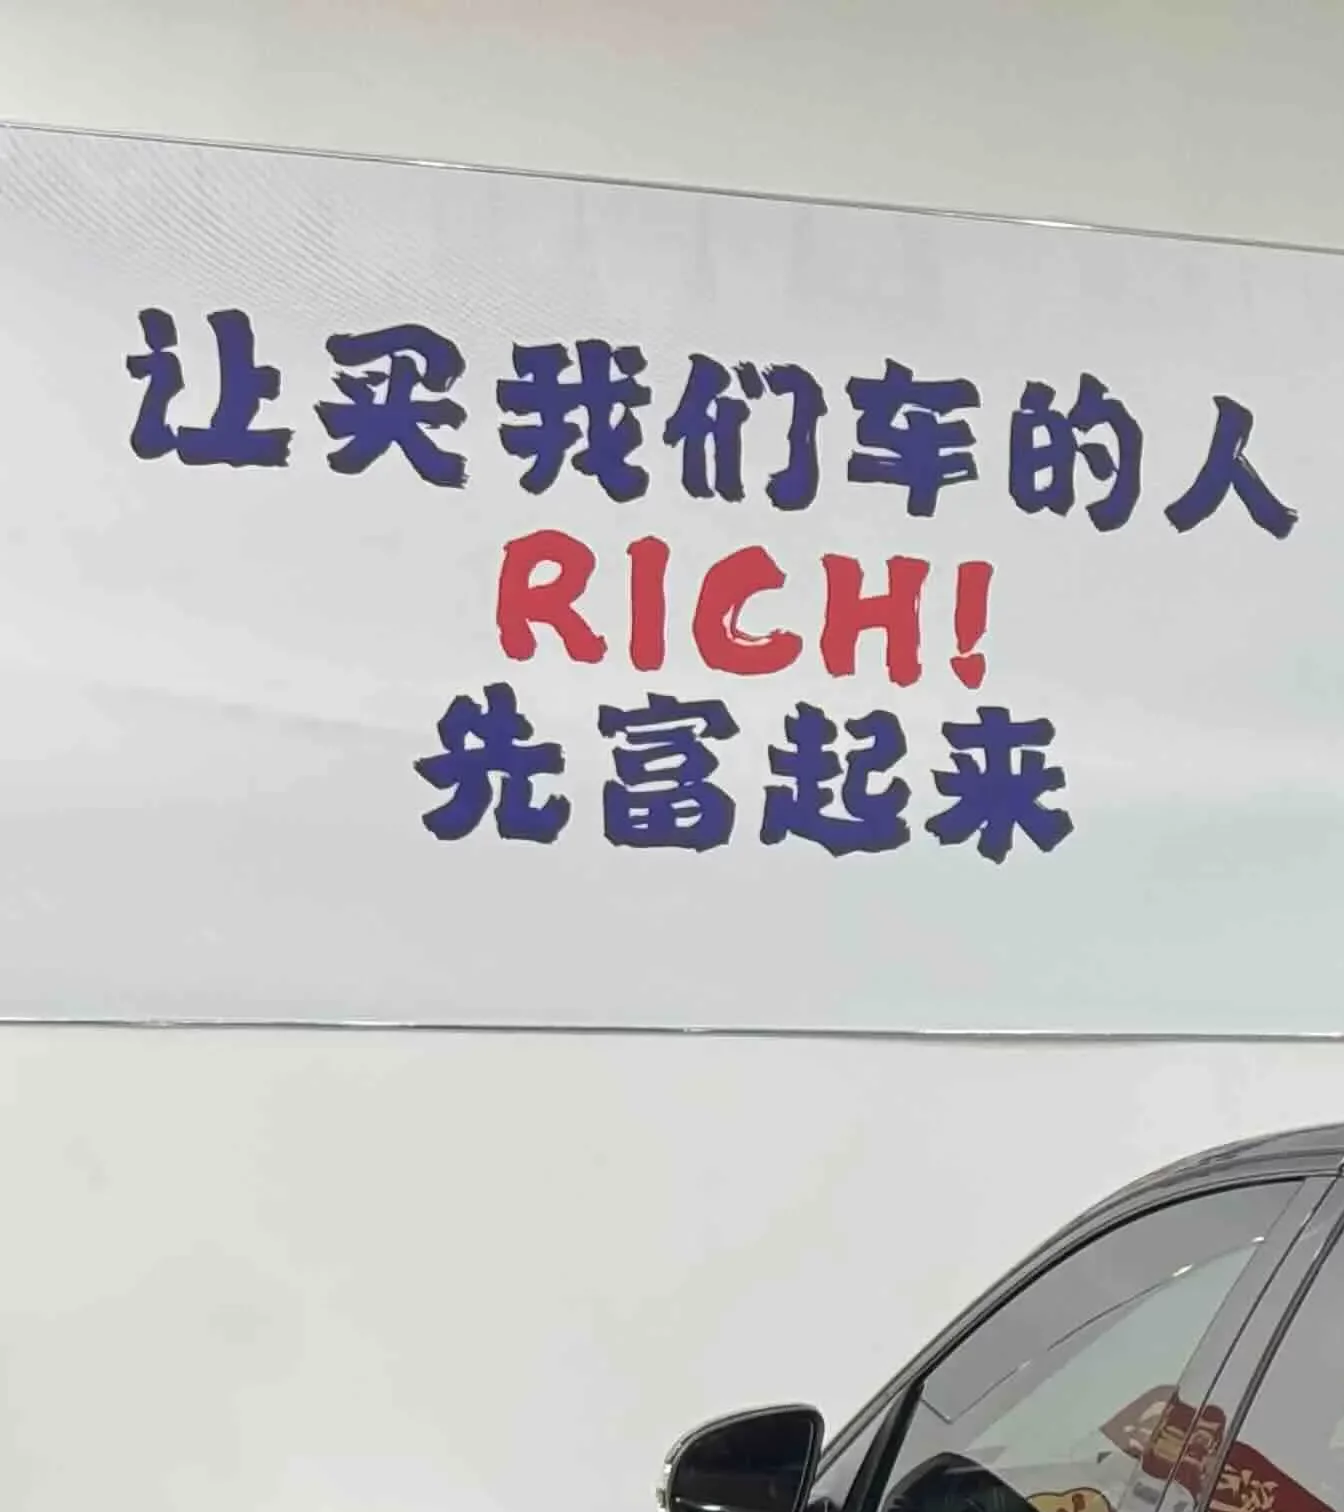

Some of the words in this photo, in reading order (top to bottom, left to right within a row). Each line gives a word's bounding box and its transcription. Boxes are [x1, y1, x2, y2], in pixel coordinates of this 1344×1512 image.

[126, 308, 1299, 539] 让买我们车的人
[497, 530, 992, 688] RICH!
[414, 682, 1074, 864] 先富起来
